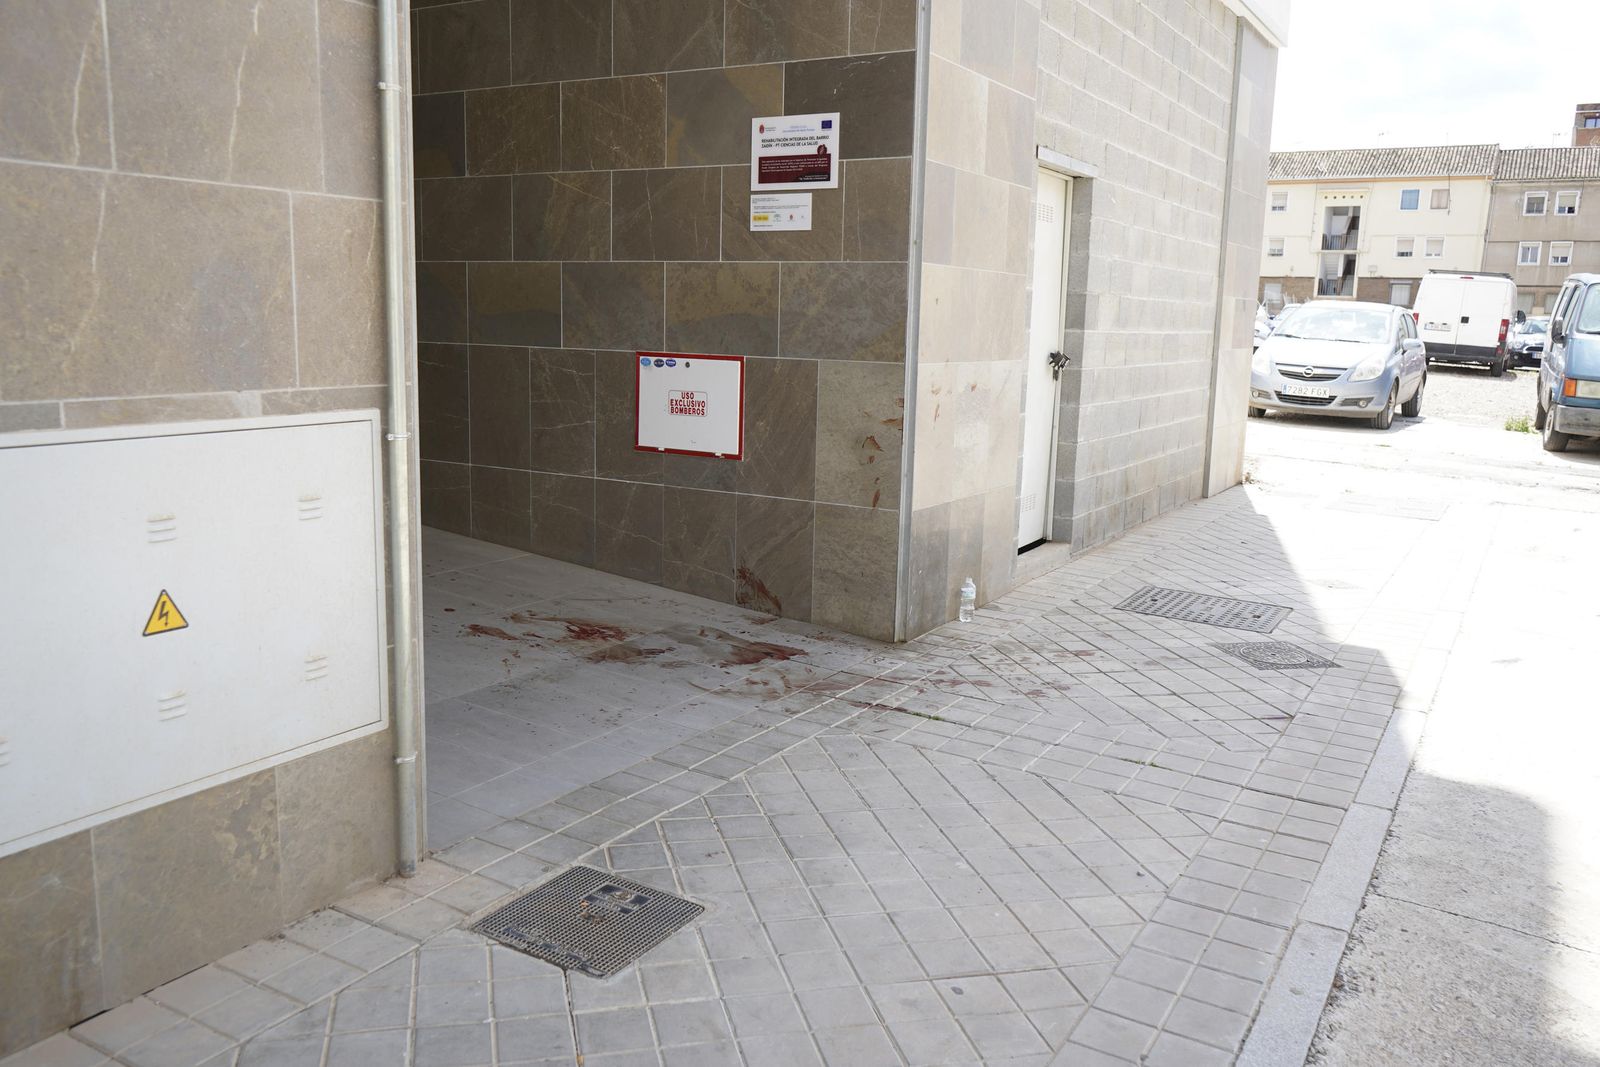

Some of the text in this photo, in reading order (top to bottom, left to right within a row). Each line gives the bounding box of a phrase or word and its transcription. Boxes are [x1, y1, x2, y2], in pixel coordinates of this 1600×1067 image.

[1287, 386, 1328, 396] 7282 FGX
[681, 392, 695, 400] USO
[670, 399, 706, 408] EXCLUSIVO
[670, 407, 705, 416] BOMBEROS
